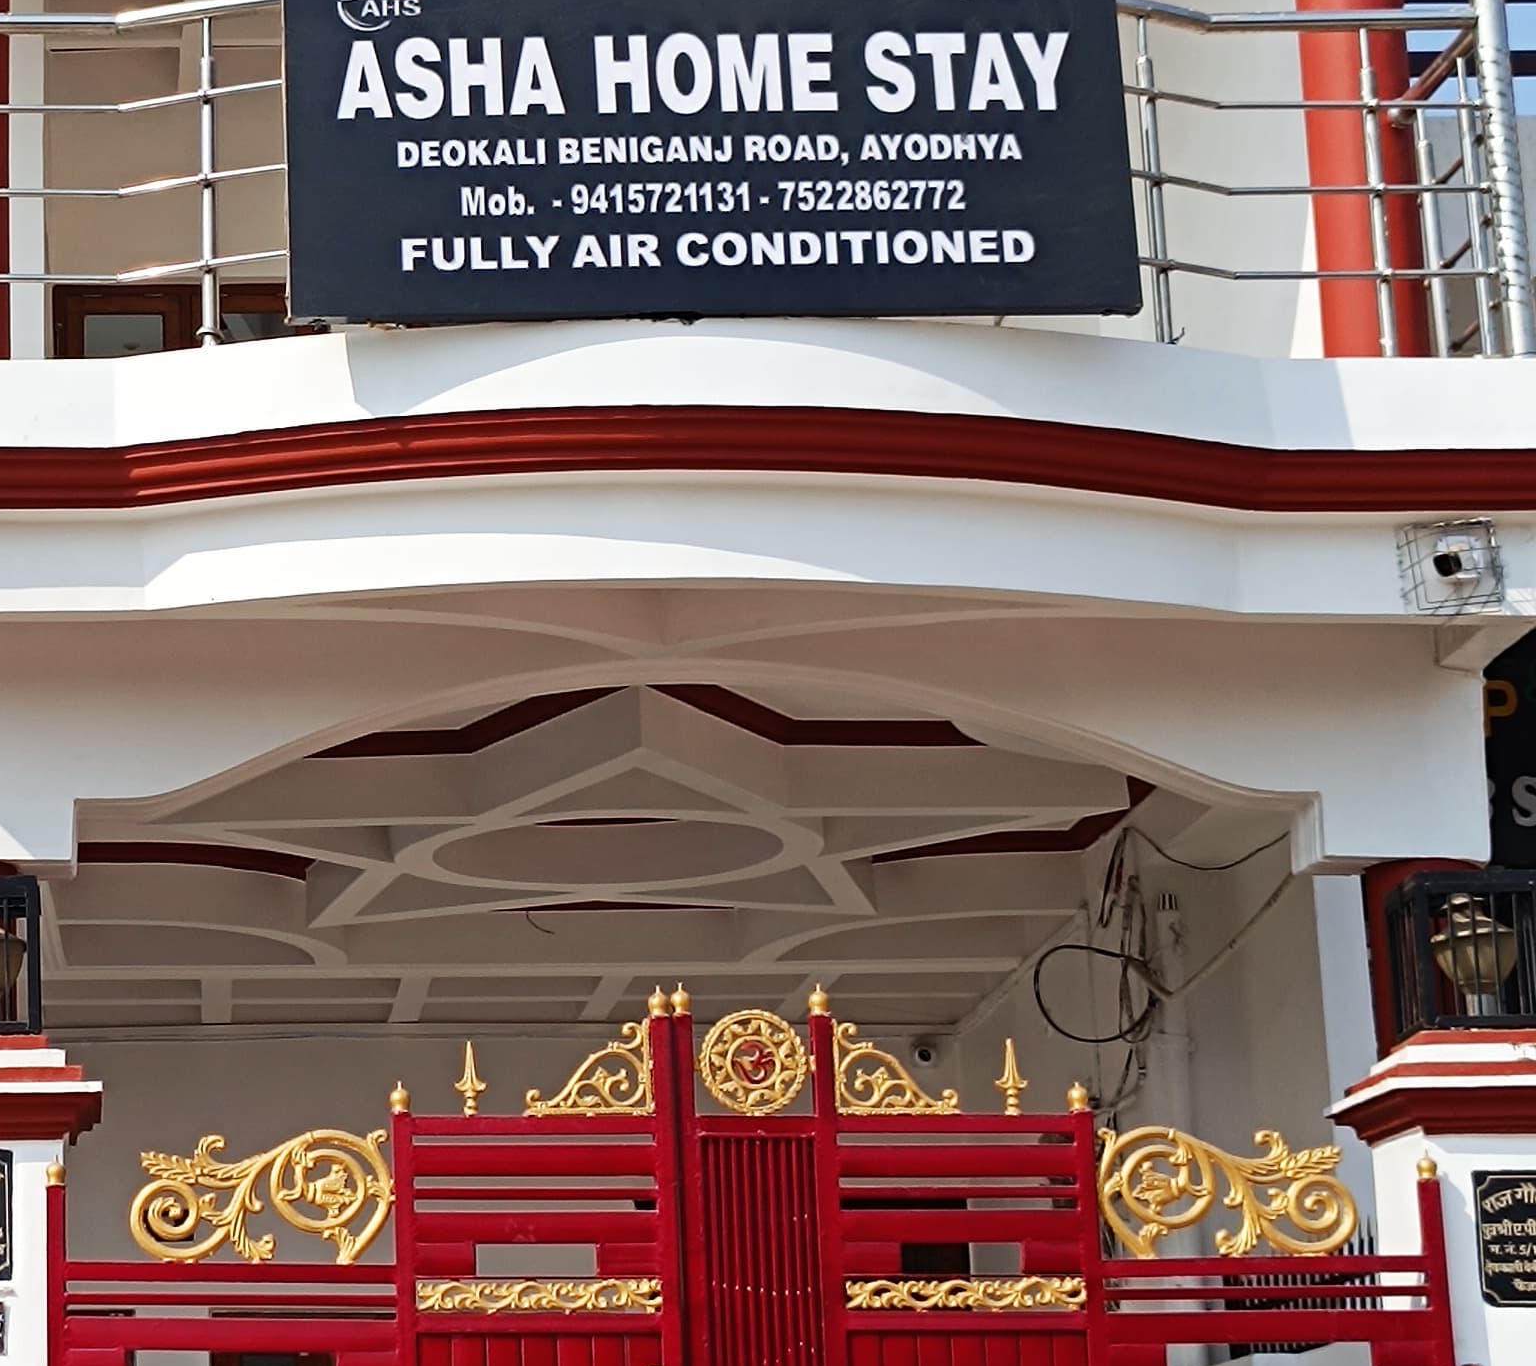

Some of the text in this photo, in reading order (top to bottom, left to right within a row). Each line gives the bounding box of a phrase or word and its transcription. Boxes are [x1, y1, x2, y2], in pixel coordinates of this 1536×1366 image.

[337, 31, 1069, 119] ASHA HOME STAY
[397, 133, 1023, 168] DEOKALI BENIGANJ ROAD, AYODHYA
[461, 185, 535, 217] Mob.
[571, 182, 750, 215] 9415721131
[778, 180, 966, 211] 7522862772
[401, 230, 1036, 271] FULLY AIR CONDITIONED
[1481, 1189, 1513, 1214] राज
